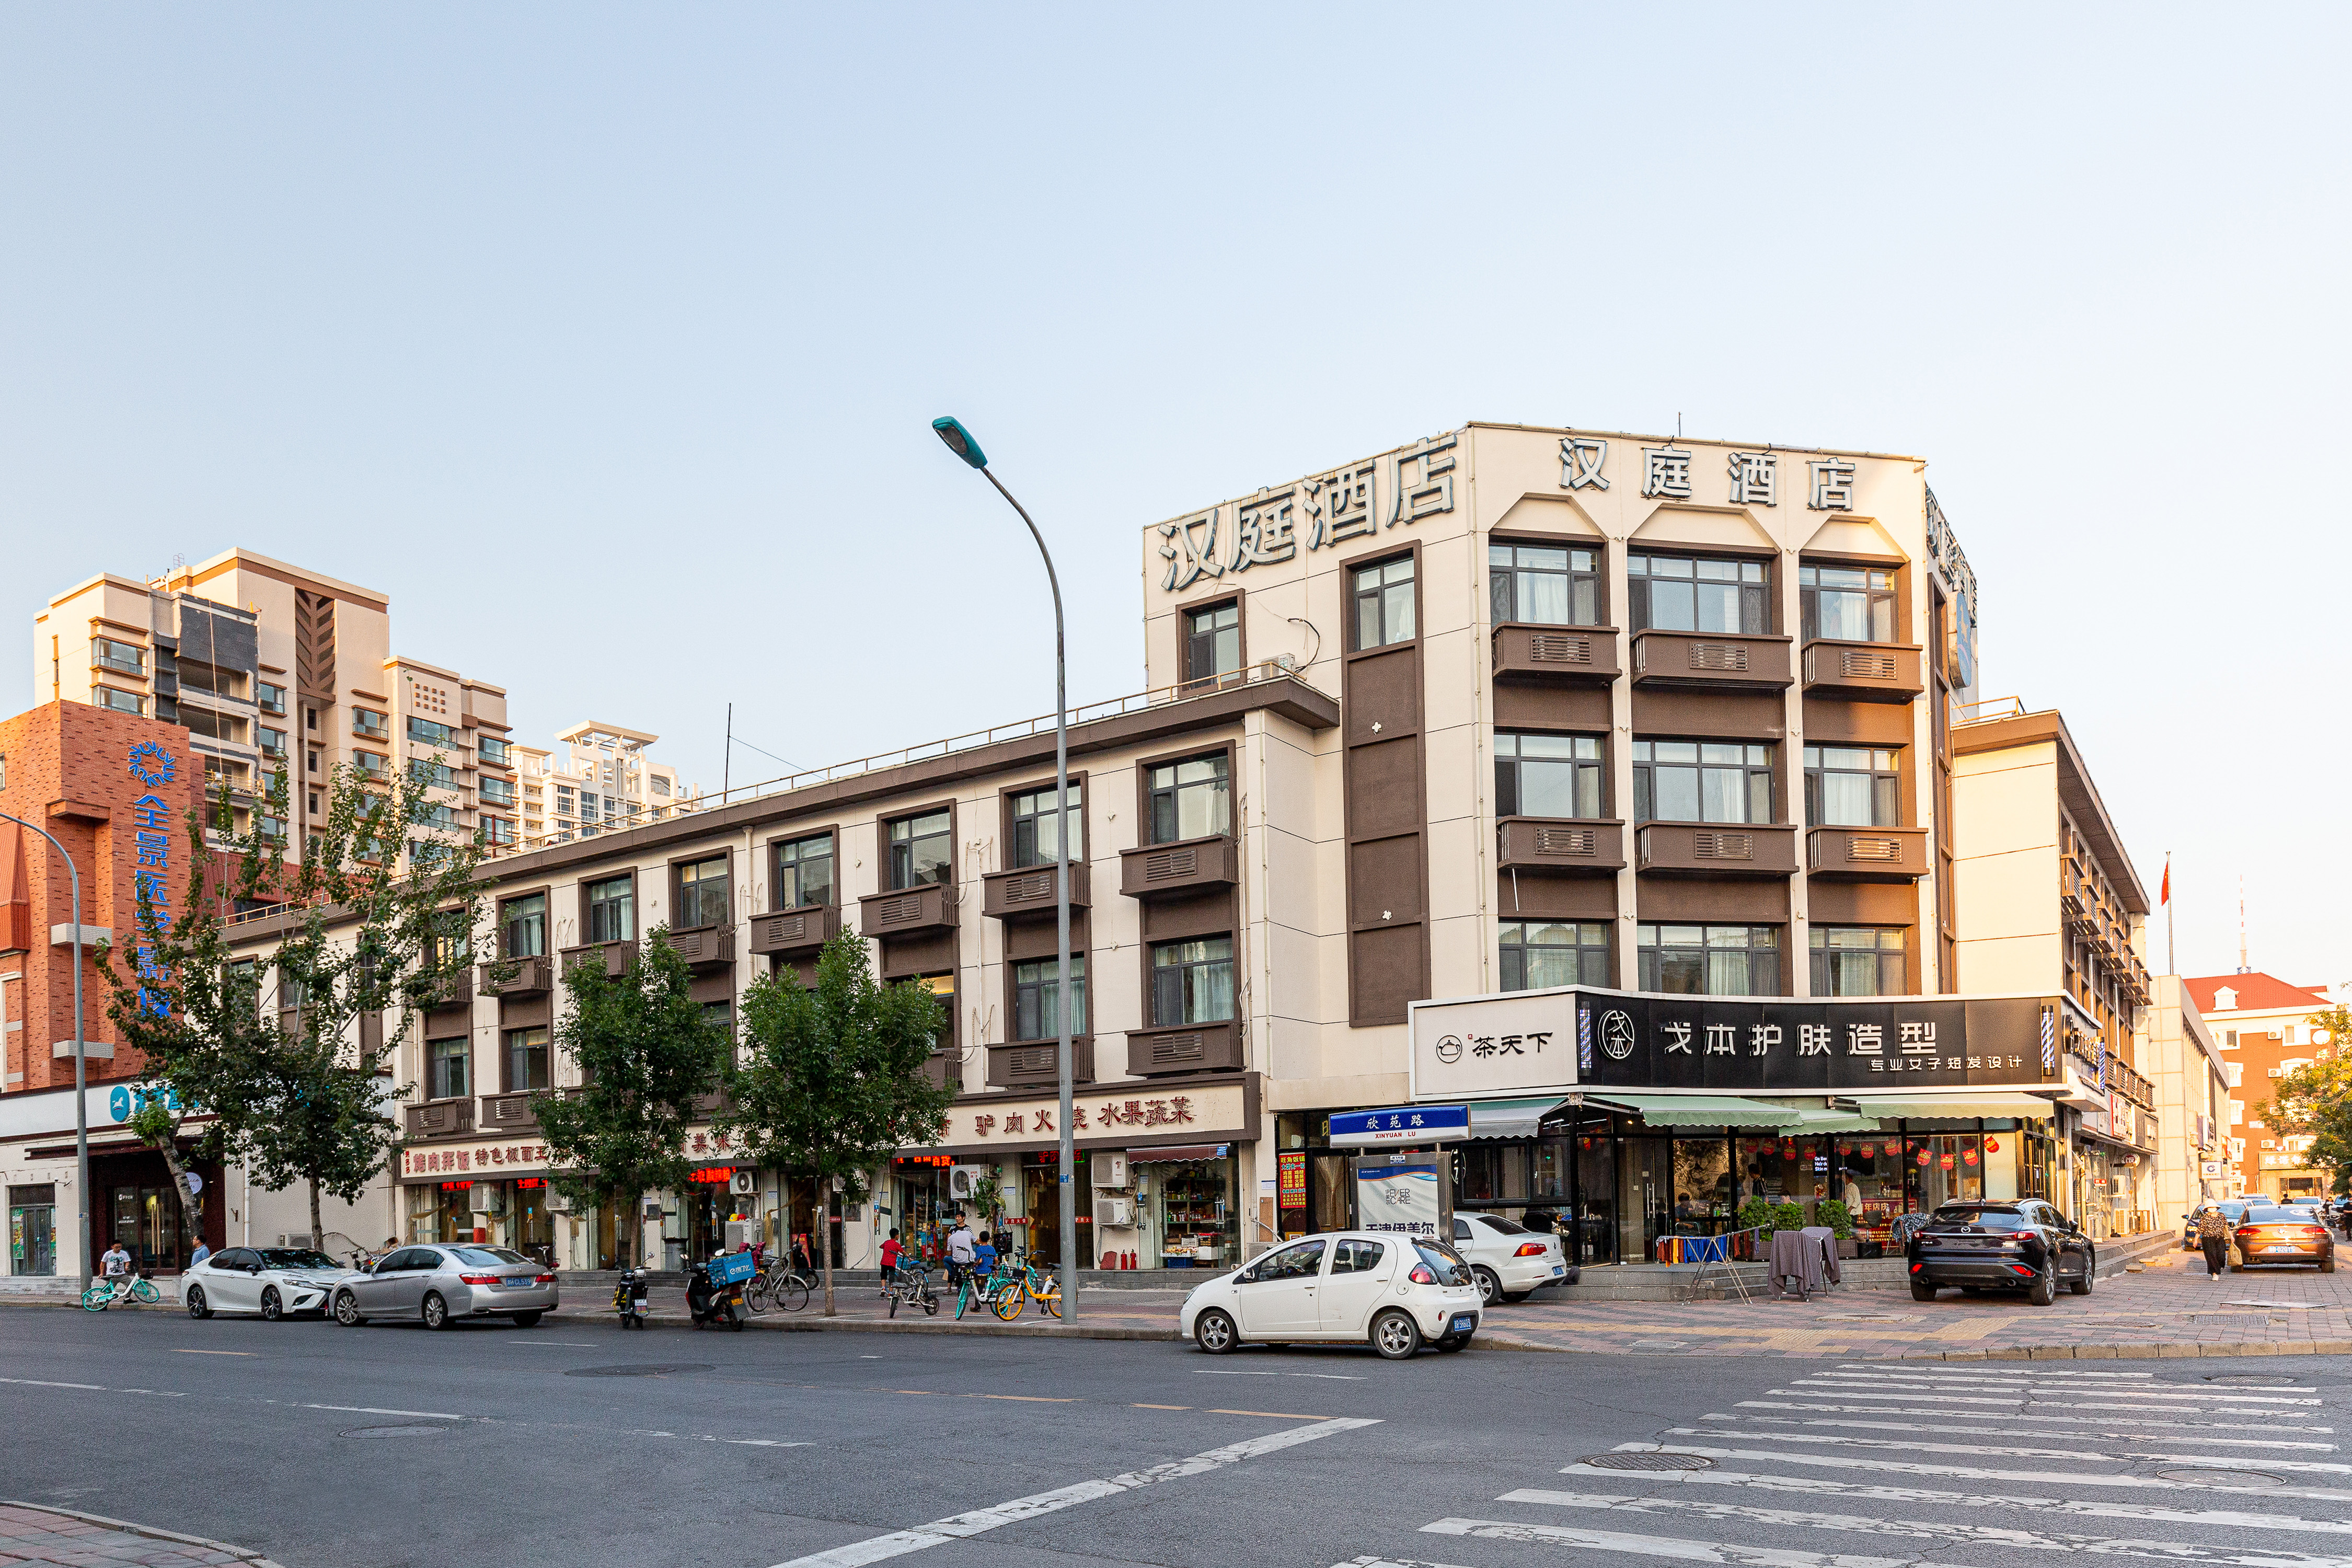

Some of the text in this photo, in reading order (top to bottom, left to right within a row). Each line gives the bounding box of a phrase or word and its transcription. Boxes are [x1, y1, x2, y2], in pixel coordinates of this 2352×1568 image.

[1559, 437, 1857, 511] 汉庭酒店
[1158, 434, 1457, 591] 汉庭酒店
[1472, 1032, 1553, 1059] 茶天下
[1661, 1022, 1936, 1056] 戈本护肤造型
[1869, 1055, 2023, 1072] 专业女子短发设计
[975, 1105, 1089, 1136] 驴肉火烧
[1098, 1097, 1193, 1127] 水果蔬菜
[1366, 1114, 1424, 1129] 欣苑路
[1390, 1189, 1410, 1197] EVER
[1862, 1203, 1887, 1212] 年店庆
